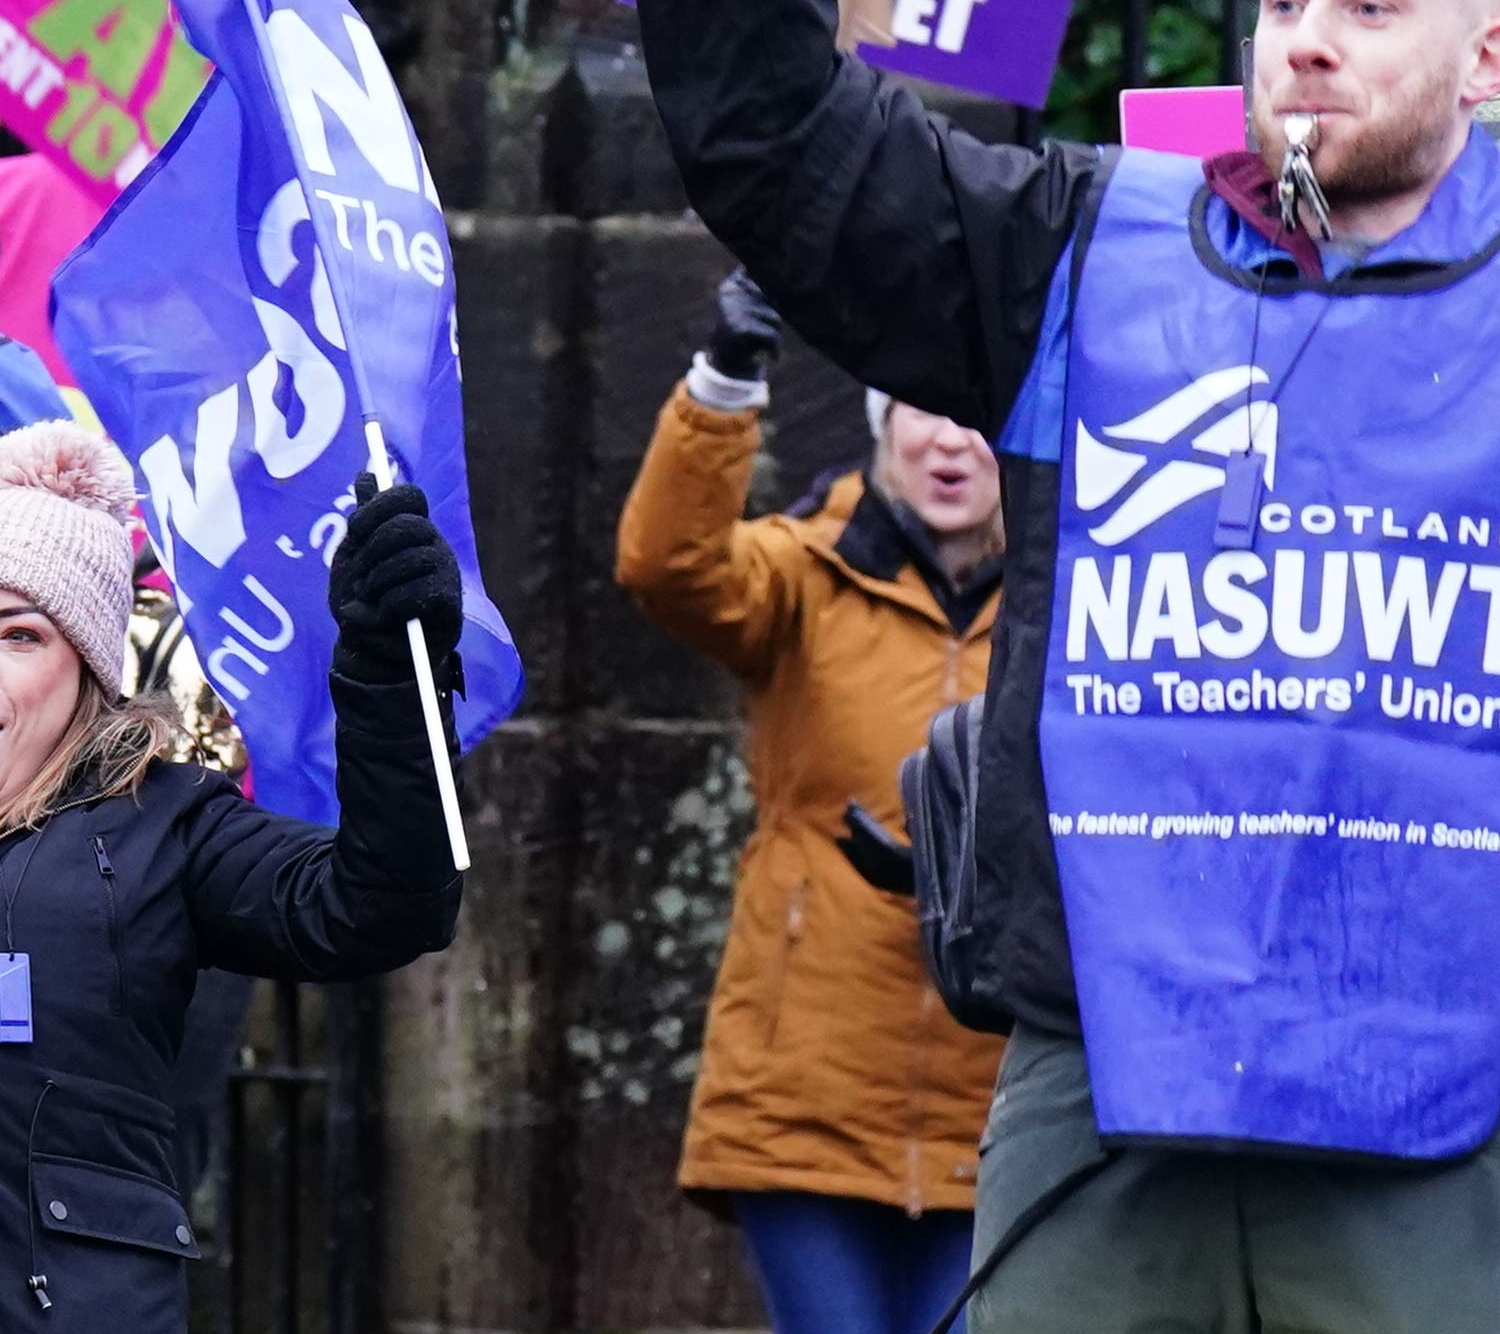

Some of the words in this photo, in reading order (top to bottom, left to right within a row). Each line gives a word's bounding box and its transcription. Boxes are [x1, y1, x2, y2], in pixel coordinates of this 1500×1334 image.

[315, 191, 445, 288] The
[1066, 671, 1142, 715] The
[1151, 667, 1367, 717] Teachers'
[1077, 810, 1148, 836] fastest
[1152, 811, 1233, 839] growing
[1239, 810, 1335, 836] teachers'
[1337, 815, 1400, 843] union
[1405, 820, 1425, 844] in
